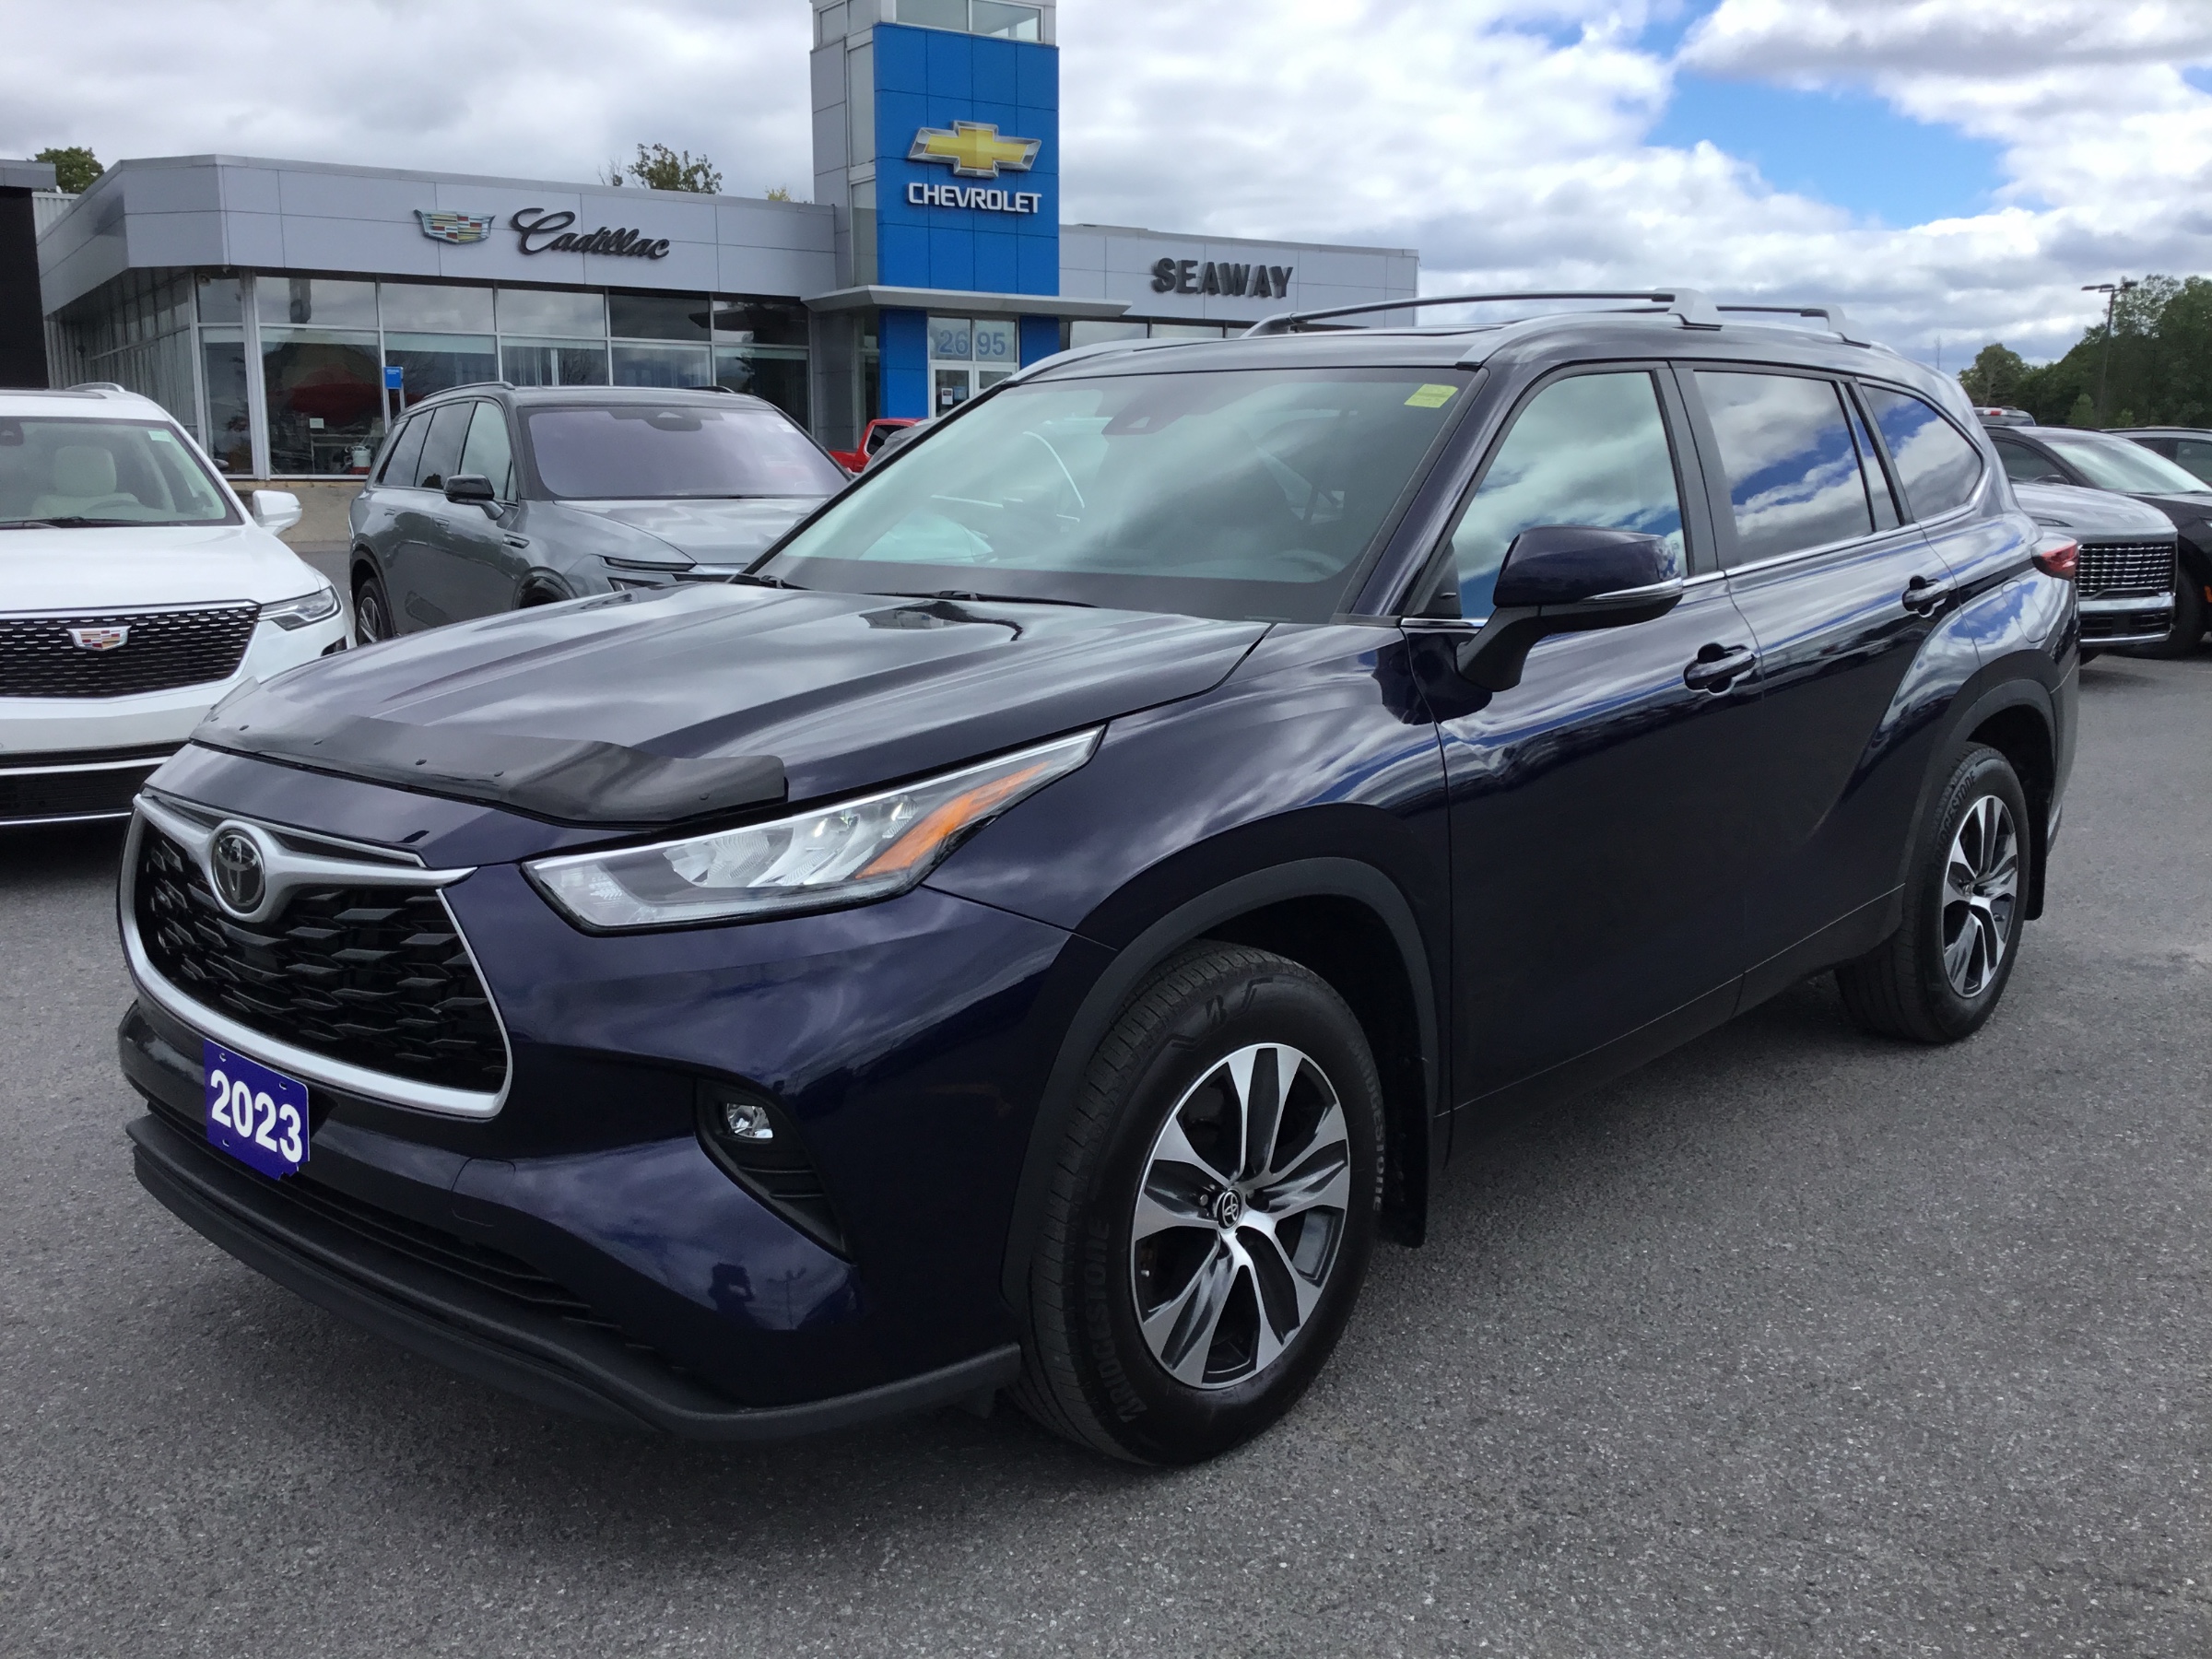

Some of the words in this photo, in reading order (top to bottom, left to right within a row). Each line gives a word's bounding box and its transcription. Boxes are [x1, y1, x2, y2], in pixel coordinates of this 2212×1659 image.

[909, 182, 1042, 214] CHEVROLET
[510, 207, 670, 260] Cadillac
[1152, 257, 1294, 299] SEAWAY
[210, 1069, 303, 1163] 2023
